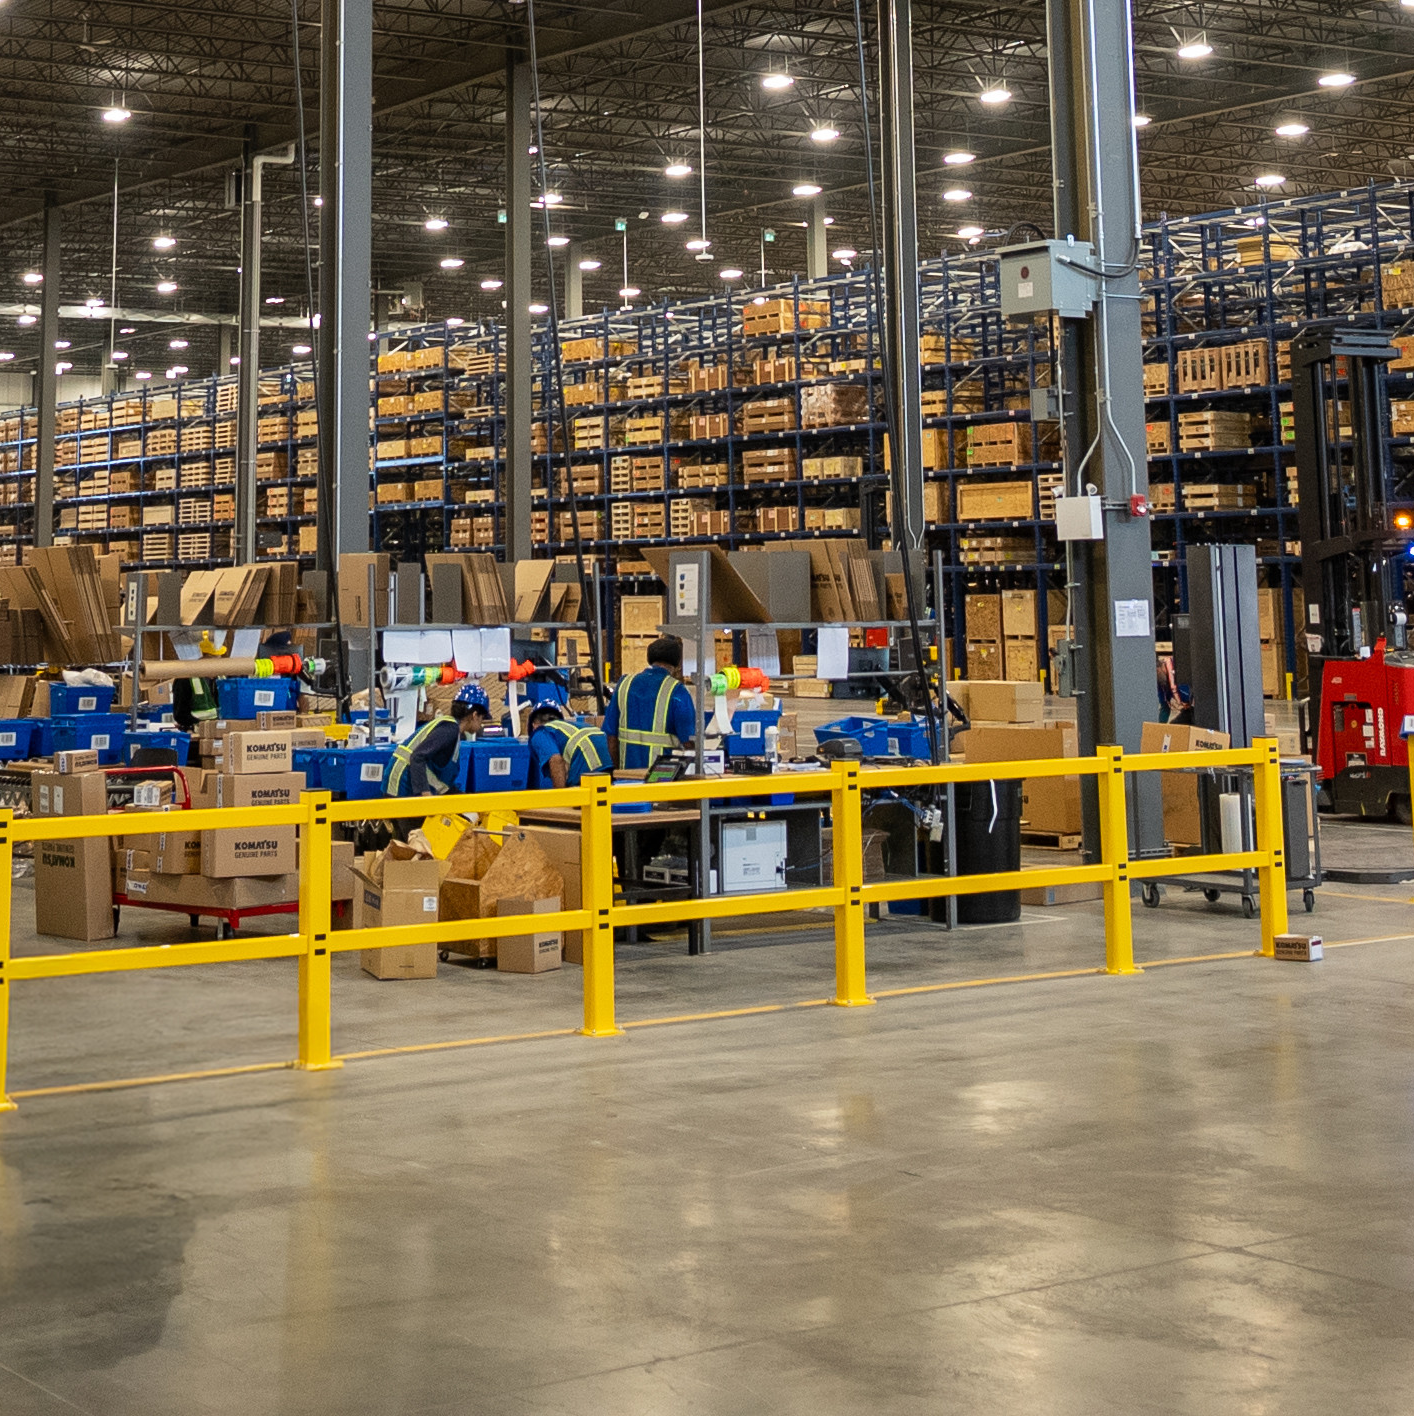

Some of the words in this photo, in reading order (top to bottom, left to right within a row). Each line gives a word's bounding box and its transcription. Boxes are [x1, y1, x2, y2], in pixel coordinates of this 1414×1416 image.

[1377, 707, 1386, 757] RAYMOND
[246, 742, 287, 753] KOMATSU
[246, 753, 269, 761] GENUINE
[270, 752, 287, 760] PARTS
[251, 788, 290, 799] KOMATSU
[234, 839, 278, 851] KOMATSU
[234, 850, 259, 859] GENUINE
[260, 849, 278, 857] PARTS
[42, 853, 76, 868] KOMATSU
